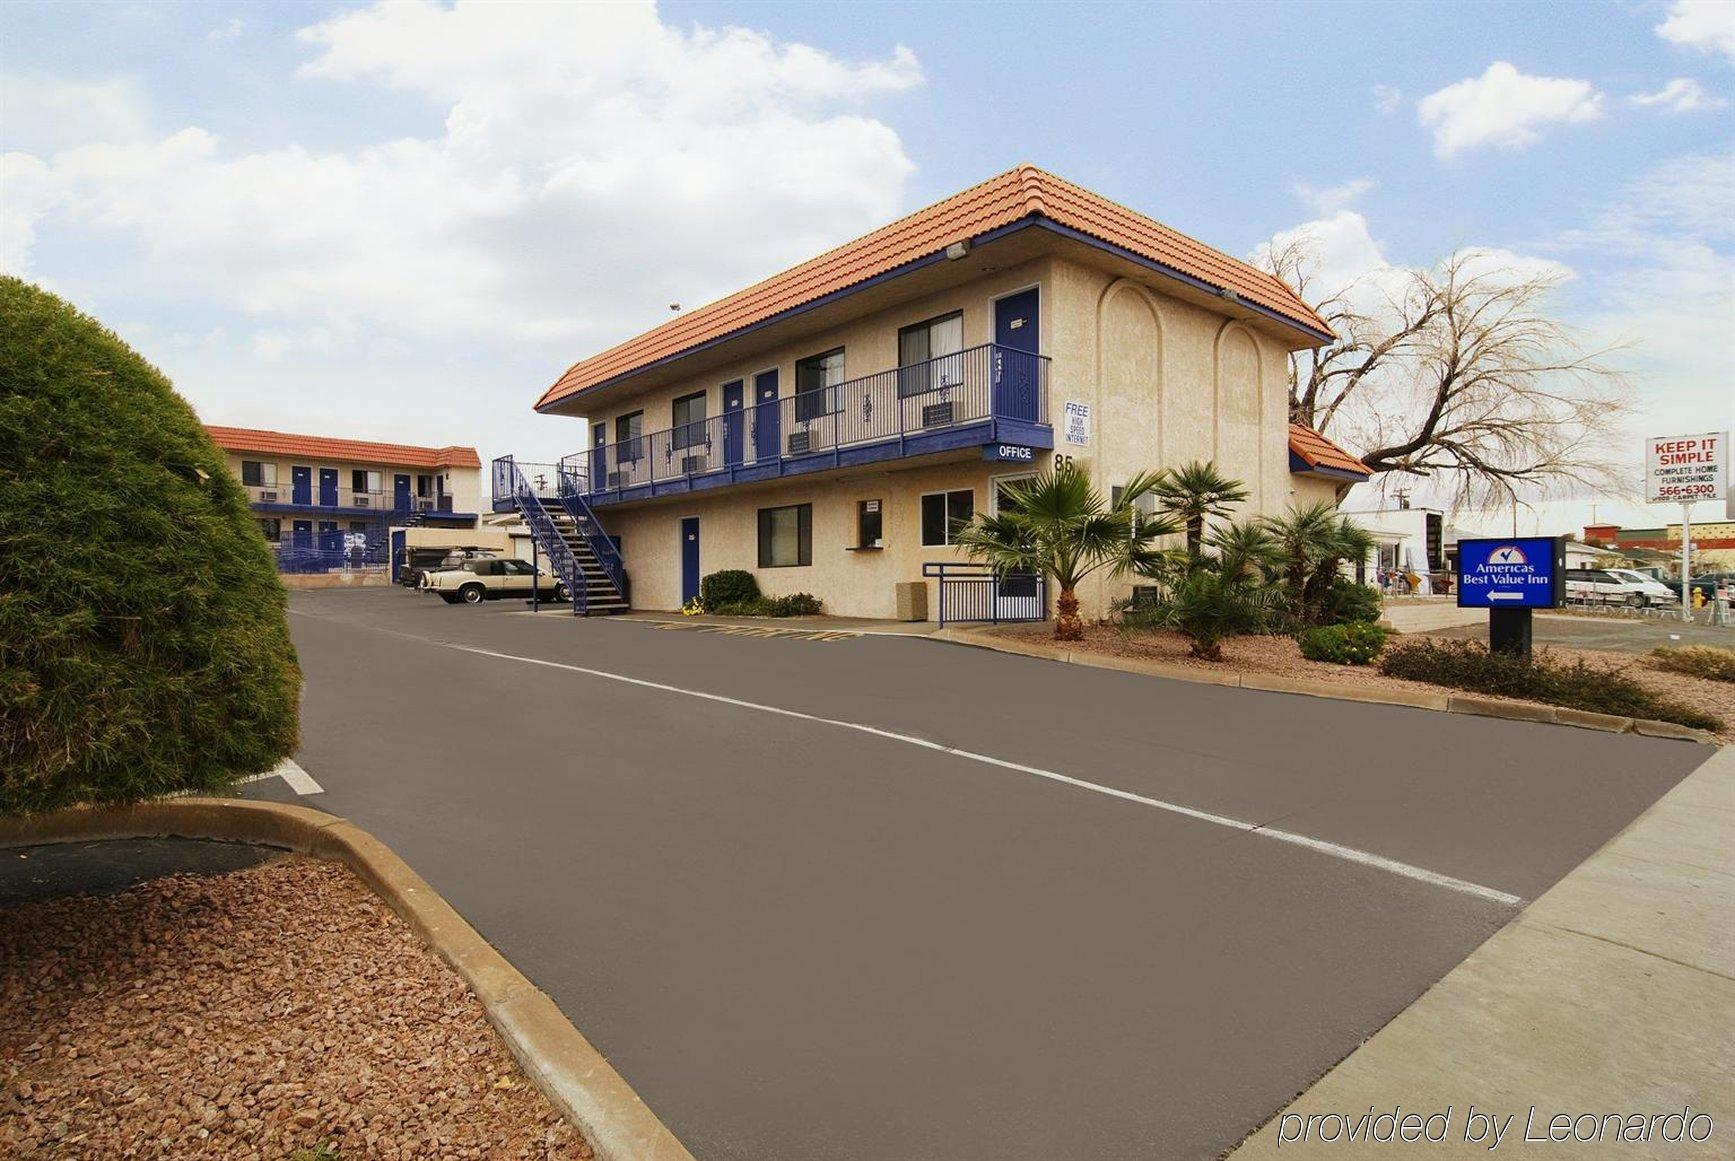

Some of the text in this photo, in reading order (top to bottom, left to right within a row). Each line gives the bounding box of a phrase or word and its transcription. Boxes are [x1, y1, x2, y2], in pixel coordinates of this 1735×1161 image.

[1065, 402, 1089, 417] FREE
[1071, 416, 1083, 425] HIGH
[1070, 425, 1085, 435] SPEED
[1066, 434, 1089, 444] INTERNET
[1655, 438, 1717, 454] KEEP IT
[999, 445, 1031, 459] OFFICE
[1660, 451, 1714, 465] SIMPLE
[1654, 465, 1718, 476] COMPLETE HOME
[1661, 474, 1714, 484] FURNISHINGS
[1659, 484, 1714, 496] 566-6300
[1476, 563, 1535, 573] Americas
[1463, 574, 1548, 584] Best Value Inn
